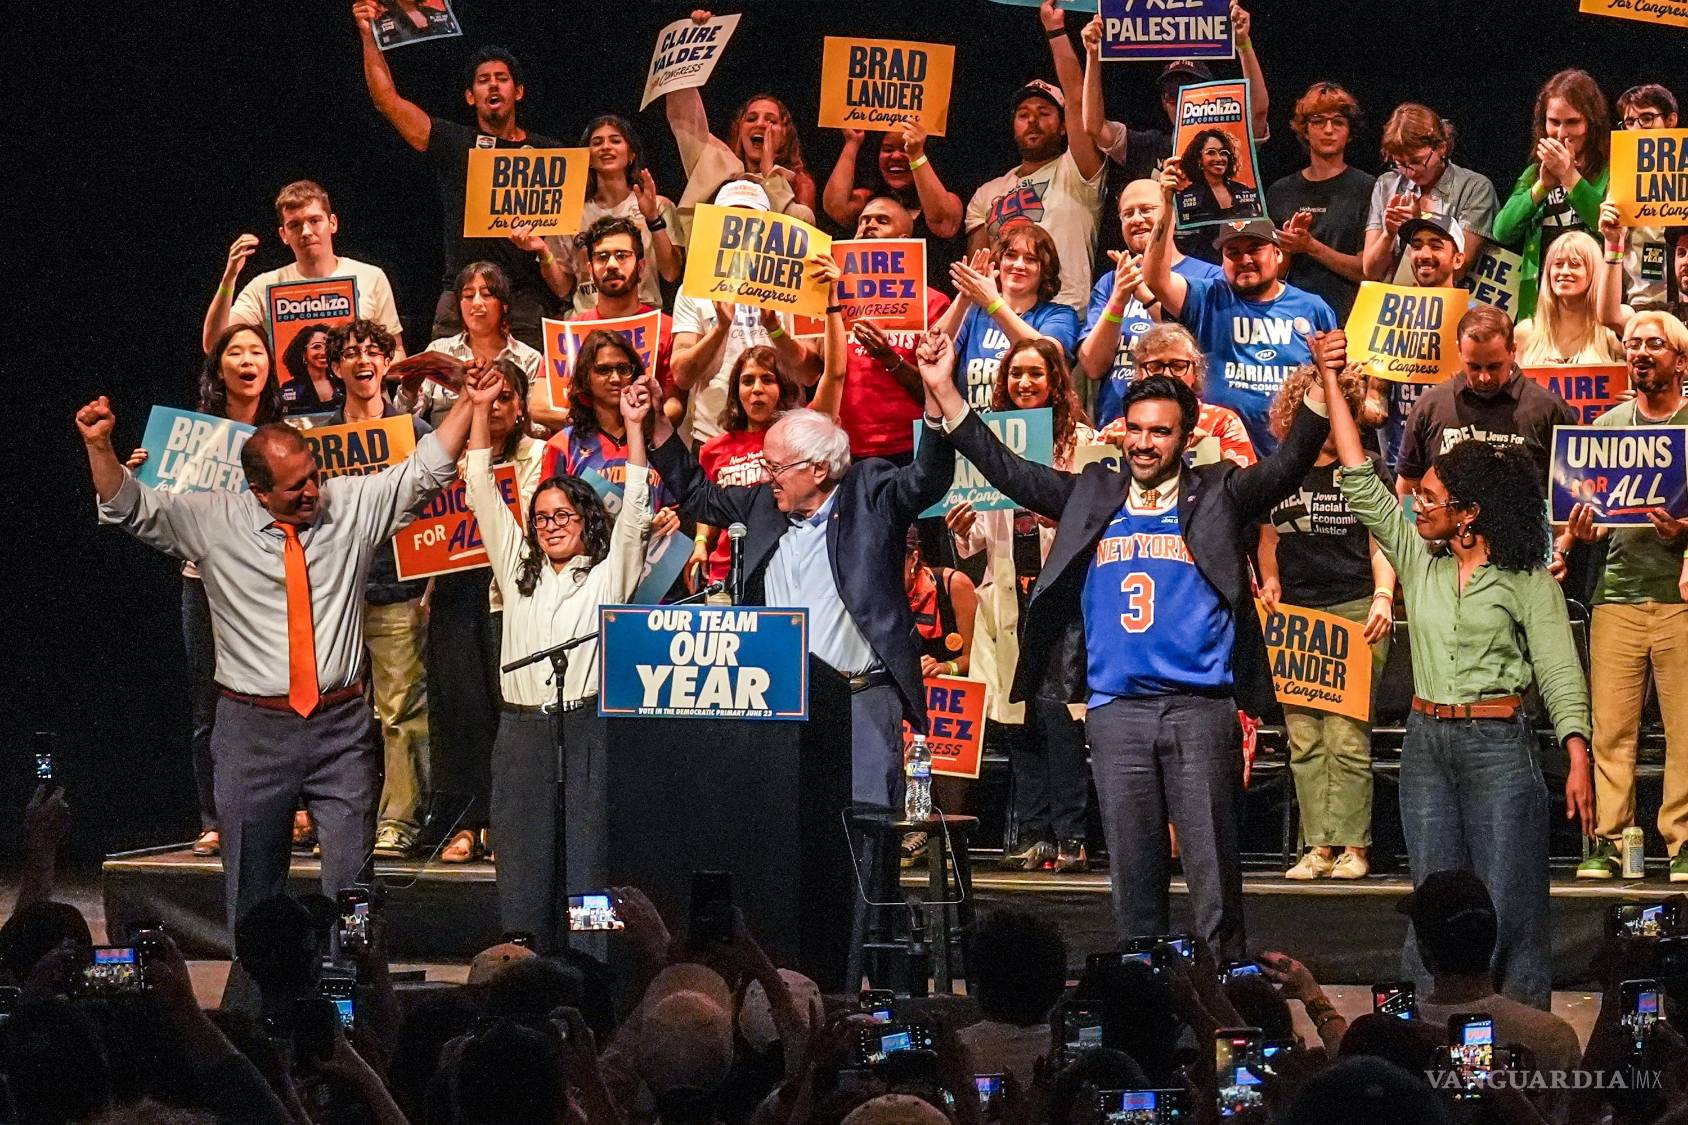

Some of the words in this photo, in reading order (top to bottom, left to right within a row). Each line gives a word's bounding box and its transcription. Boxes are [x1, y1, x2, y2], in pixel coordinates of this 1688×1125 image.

[661, 25, 723, 53] CLAIRE
[1106, 15, 1228, 42] PALESTINE
[653, 45, 717, 76] VALDEZ
[848, 45, 927, 83] BRAD
[846, 79, 923, 111] LANDER
[1183, 98, 1240, 119] Darializa
[844, 109, 868, 122] for
[1197, 115, 1240, 123] CONGRESS
[1637, 138, 1688, 172] BRA
[492, 156, 567, 188] BRAD
[490, 188, 562, 216] LANDER
[1636, 174, 1688, 202] LAND
[488, 216, 508, 230] for
[511, 217, 558, 230] Congress
[1635, 204, 1658, 218] for
[720, 216, 808, 259] BRAD
[714, 250, 804, 290] LANDER
[843, 251, 905, 275] AIRE
[710, 280, 735, 293] for
[737, 283, 797, 304] Congress
[838, 279, 916, 299] LDEZ
[276, 295, 350, 316] Darializa
[300, 310, 350, 319] CONGRESS
[1377, 293, 1444, 331] BRAD
[1233, 316, 1293, 345] UAW
[1368, 326, 1440, 360] LANDER
[1388, 358, 1440, 377] Congress
[1487, 431, 1508, 443] Jews
[1510, 433, 1525, 445] For
[1567, 435, 1673, 469] UNIONS
[1313, 492, 1337, 501] Jews
[1606, 472, 1666, 508] ALL
[1313, 502, 1342, 512] Racial
[413, 524, 446, 551] FOR
[448, 519, 484, 552] AL
[1313, 524, 1348, 535] Justice
[1097, 537, 1136, 567] NEW
[1136, 533, 1195, 565] YORK
[1121, 572, 1156, 634] 3
[648, 610, 693, 632] OUR
[699, 610, 758, 633] TEAM
[1265, 611, 1349, 660] BRAD
[669, 631, 740, 666] OUR
[1273, 650, 1347, 691] ANDER
[636, 665, 770, 710] YEAR
[1284, 680, 1343, 703] Congress
[639, 707, 654, 715] VOTE
